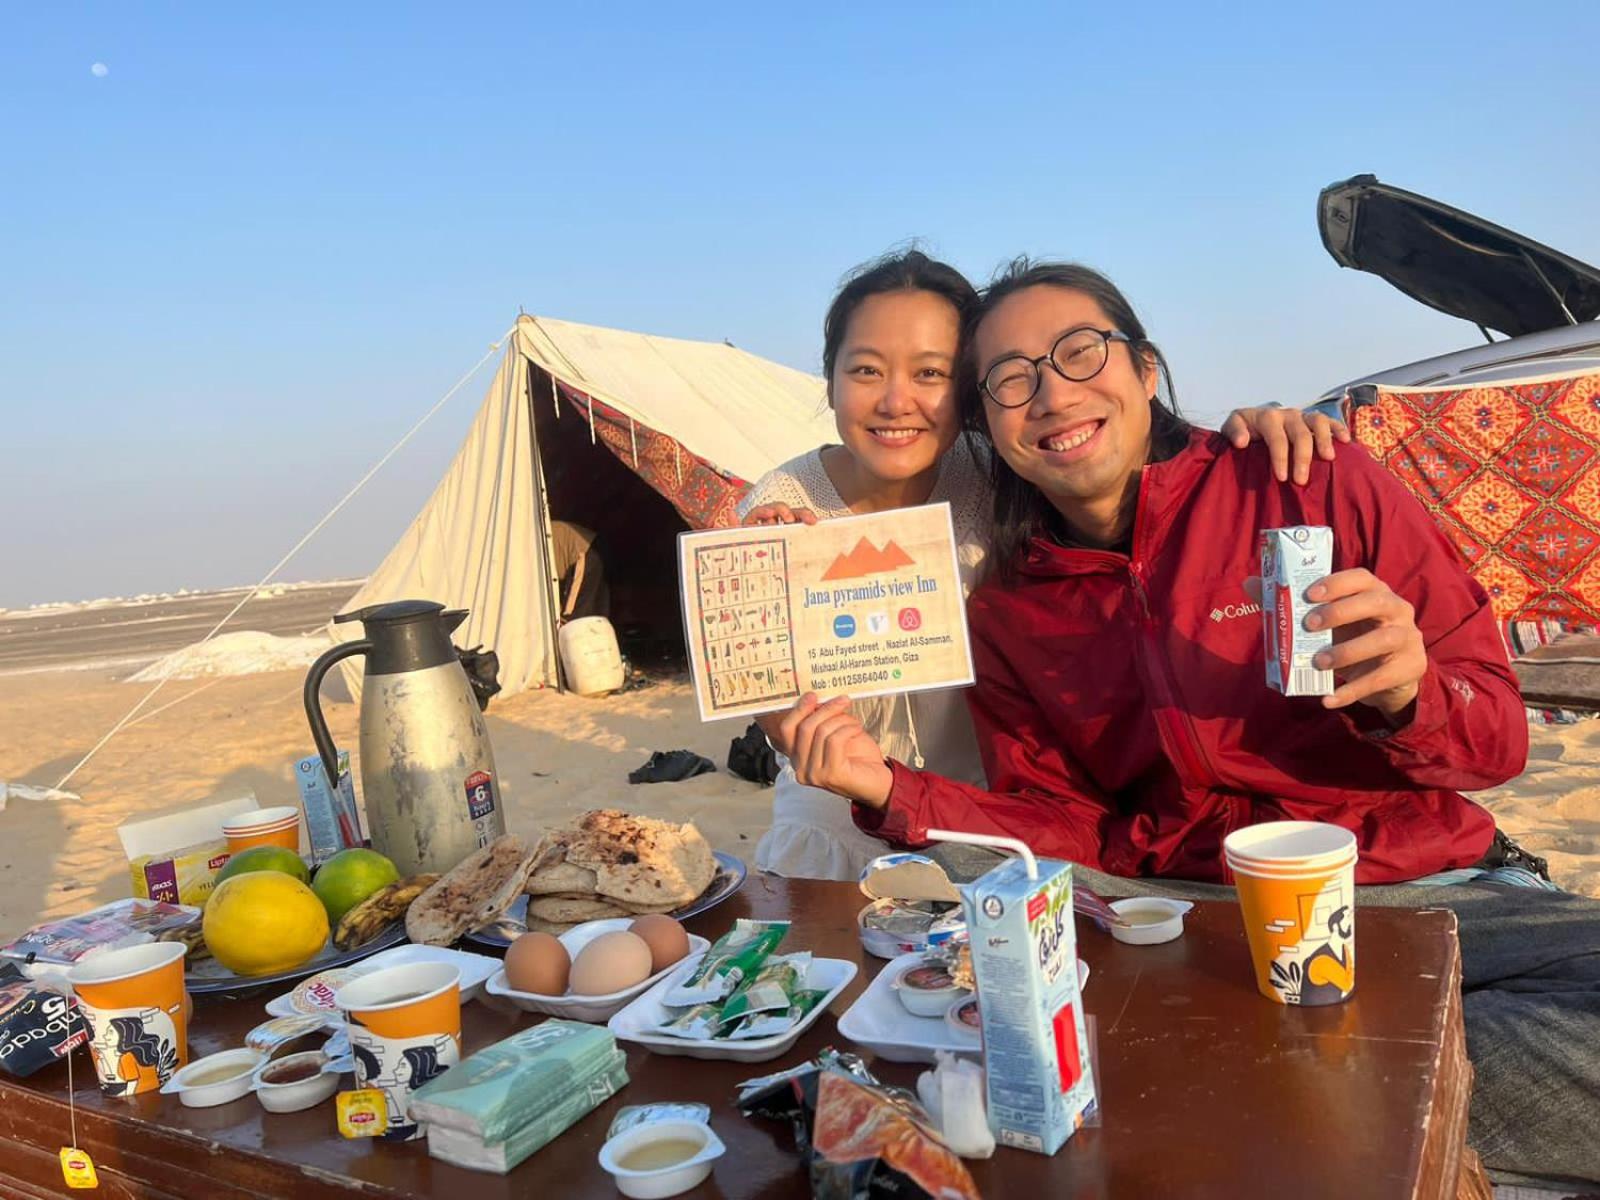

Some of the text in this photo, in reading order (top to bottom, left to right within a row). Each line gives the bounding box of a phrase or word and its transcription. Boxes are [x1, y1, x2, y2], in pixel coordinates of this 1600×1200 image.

[803, 587, 831, 608] Jana
[833, 580, 886, 608] pyramids
[888, 579, 914, 596] view
[917, 575, 937, 593] Inn
[1224, 603, 1260, 619] Colu
[807, 649, 817, 659] 15
[819, 646, 834, 658] Abu
[835, 643, 857, 657] Fayed
[858, 641, 880, 653] street
[839, 658, 873, 671] Al-Haram
[902, 651, 919, 663] Giza
[811, 678, 827, 690] Mob
[832, 670, 889, 688] 01125864040
[475, 785, 485, 801] 6
[41, 996, 66, 1022] 5
